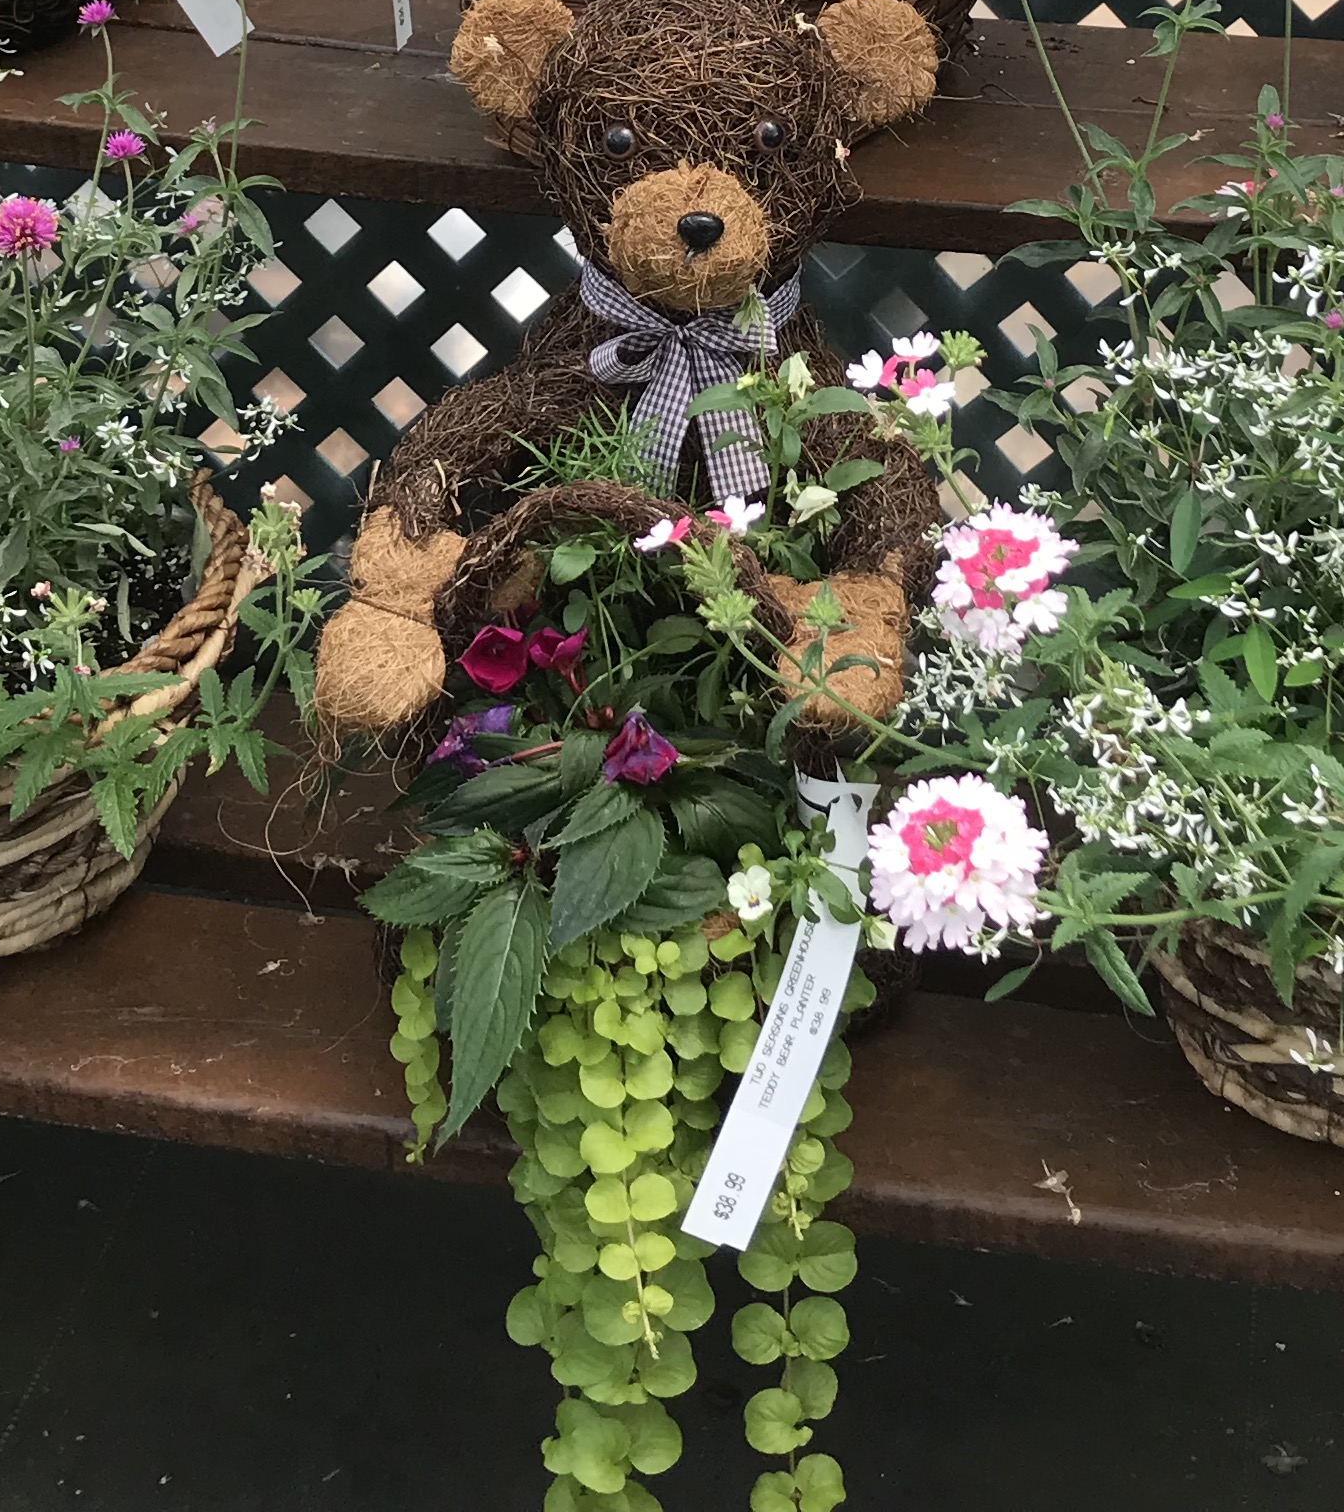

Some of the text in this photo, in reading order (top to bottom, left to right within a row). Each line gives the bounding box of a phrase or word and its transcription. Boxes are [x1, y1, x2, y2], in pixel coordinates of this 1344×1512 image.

[749, 1062, 767, 1086] TWO
[762, 1002, 789, 1057] SEASONS
[758, 973, 816, 1108] TEDDY BEAR PLANTER
[713, 1172, 746, 1220] $38.99
